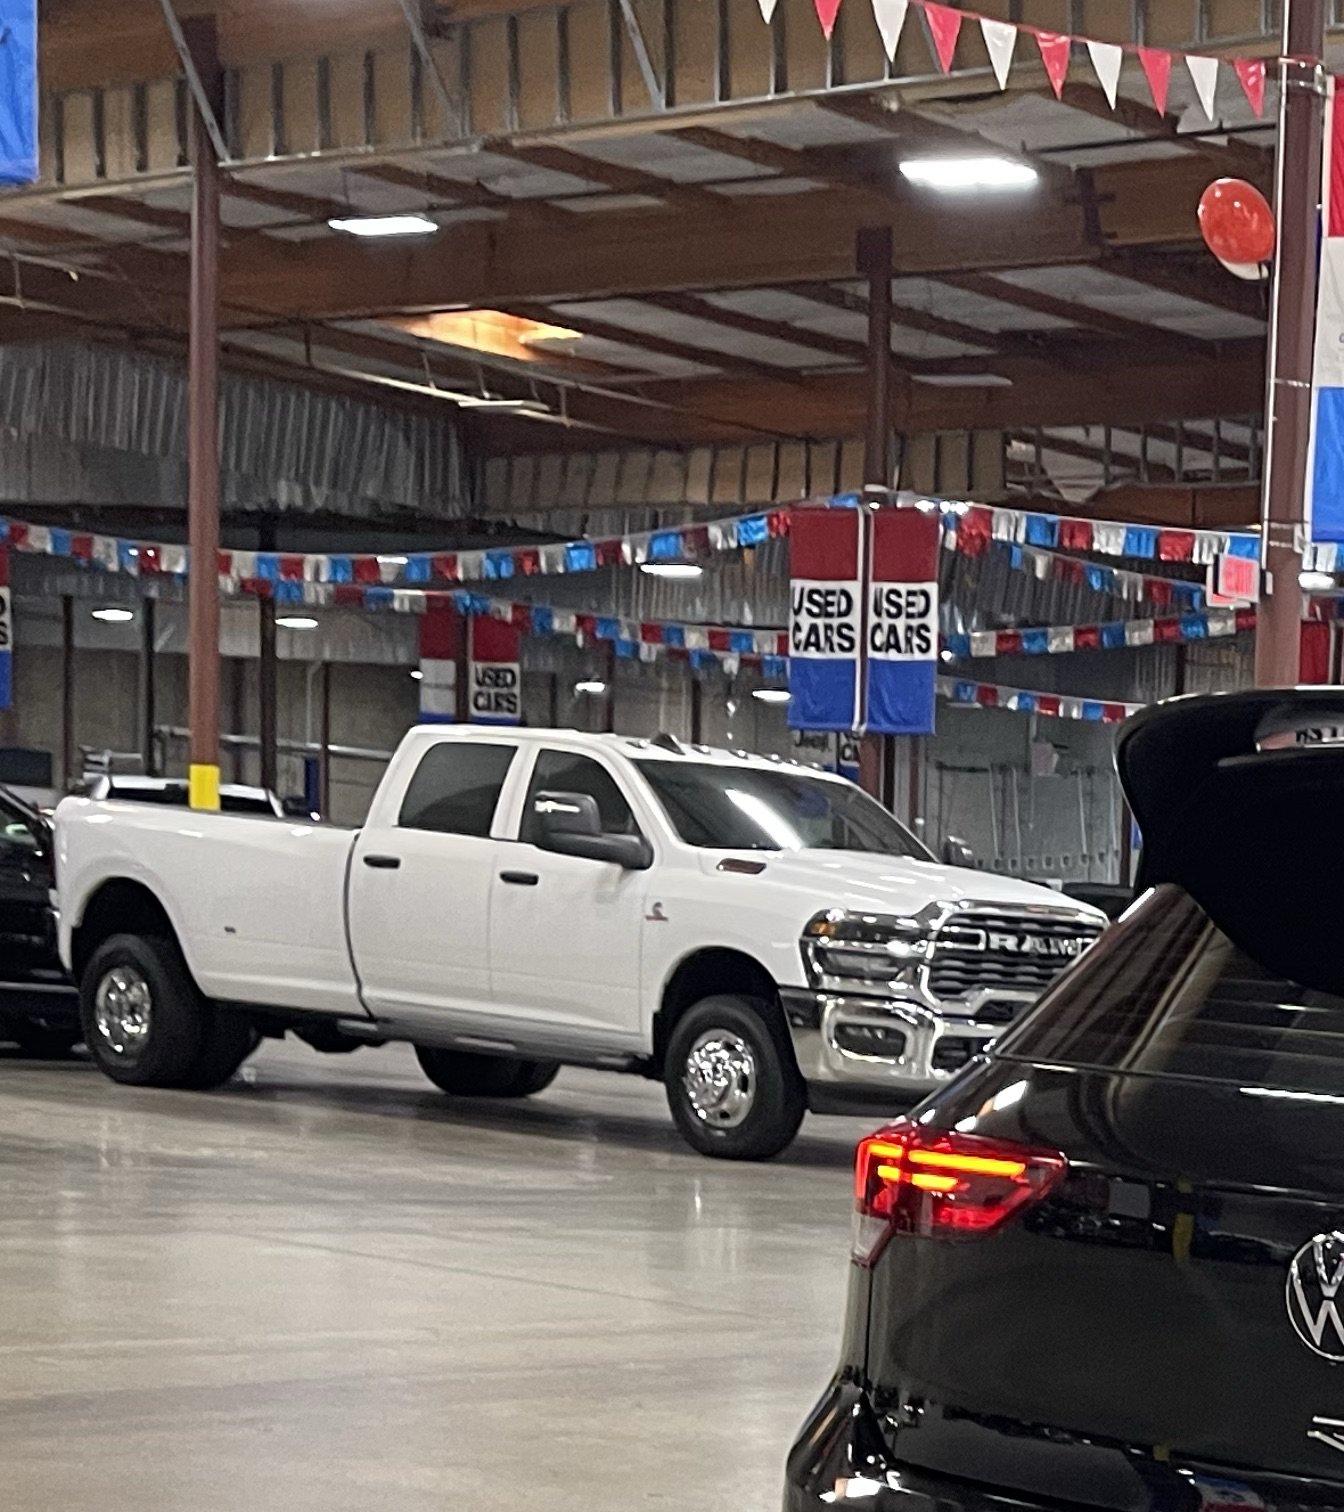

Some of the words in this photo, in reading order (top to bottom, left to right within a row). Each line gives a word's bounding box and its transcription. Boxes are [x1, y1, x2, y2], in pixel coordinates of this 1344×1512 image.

[792, 586, 853, 619] USED
[873, 587, 931, 619] USED
[792, 621, 856, 653] CARS
[870, 622, 932, 654] CARS
